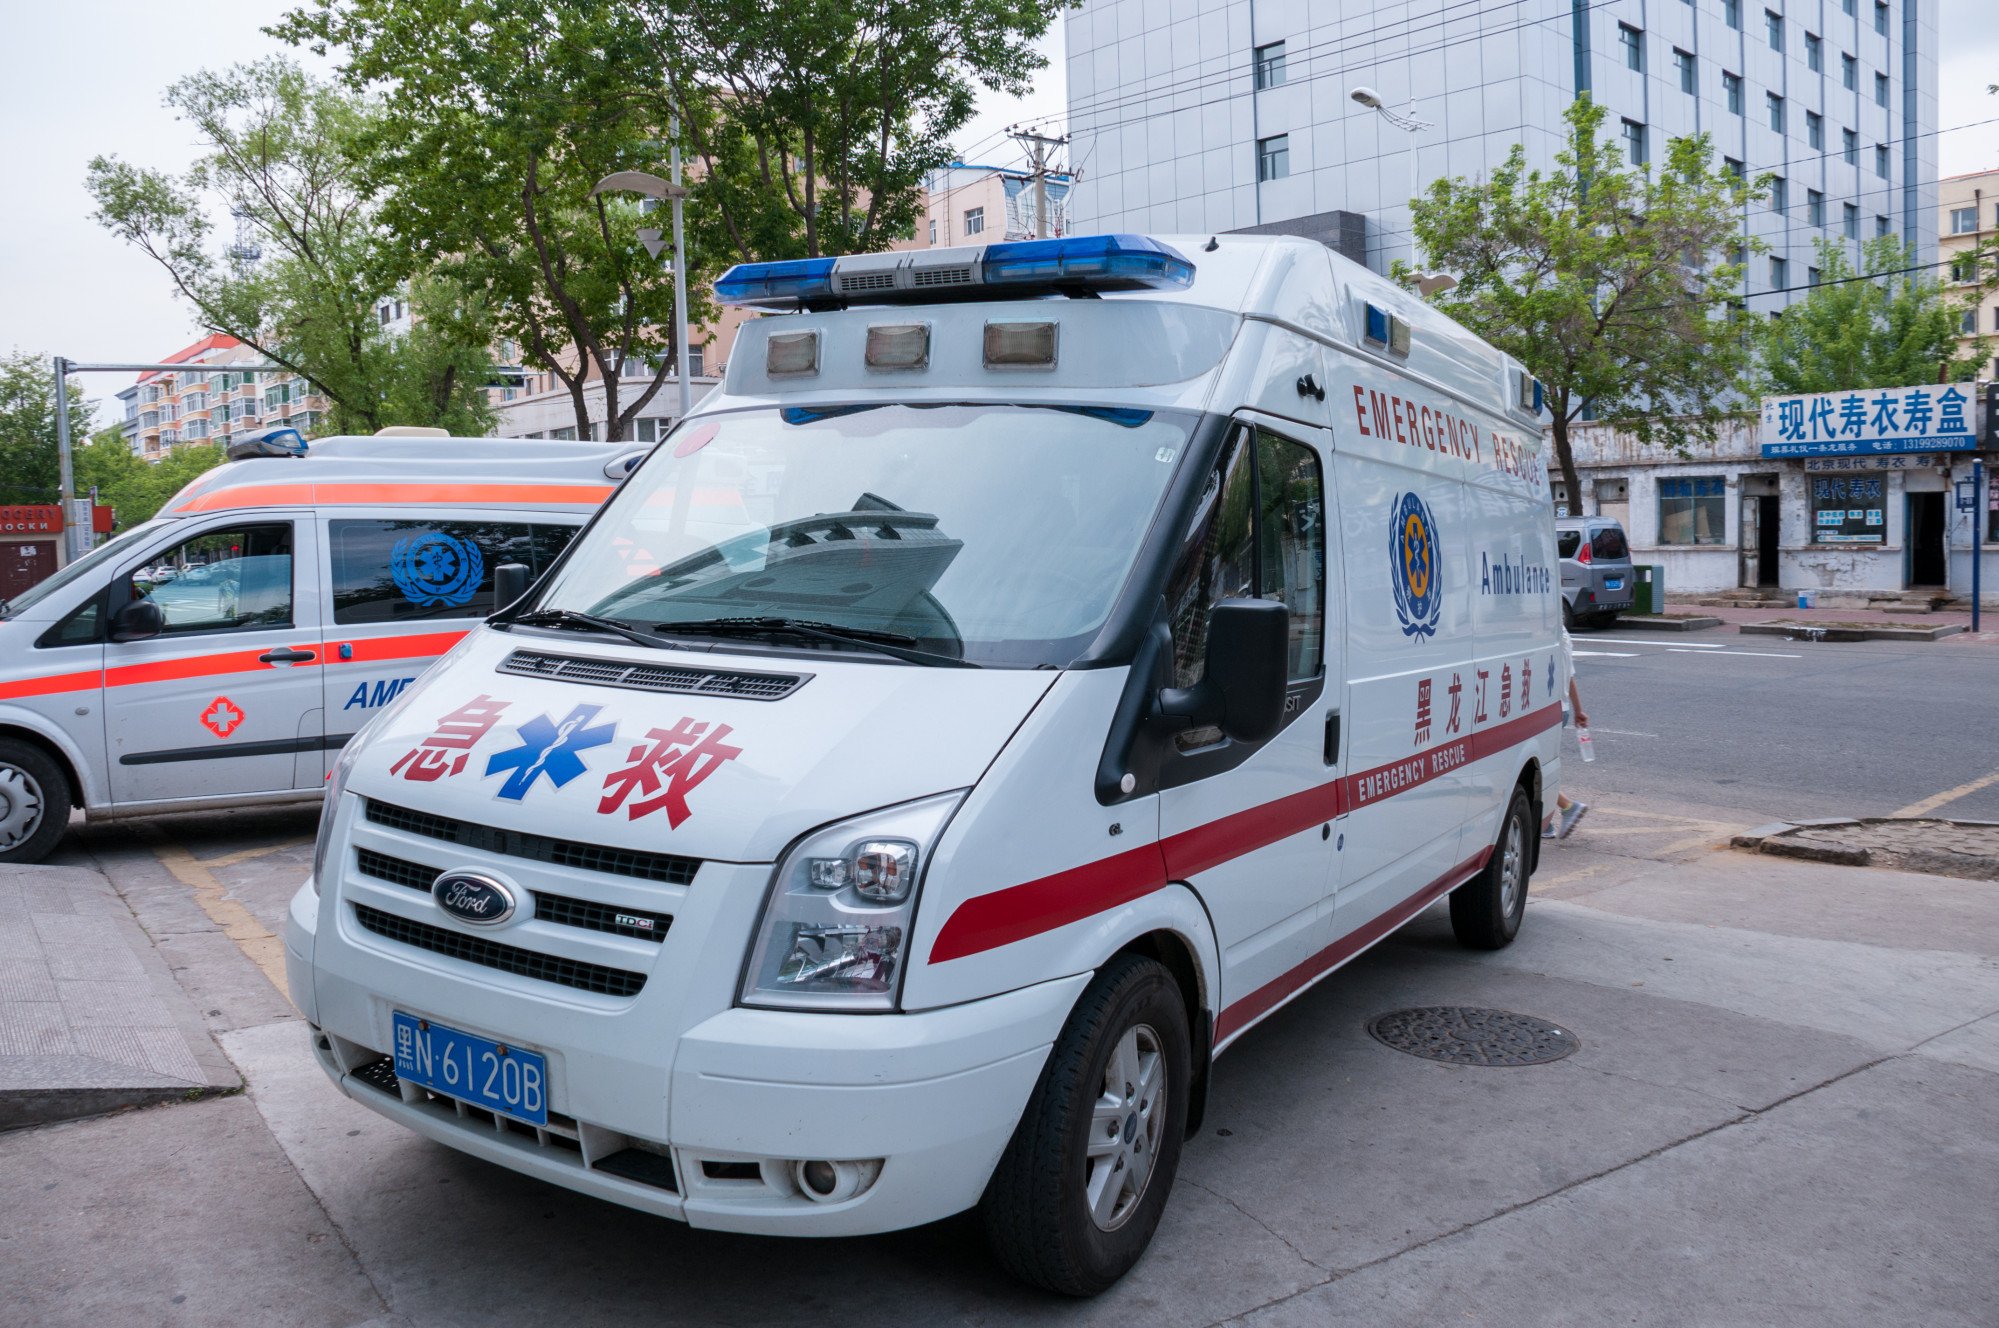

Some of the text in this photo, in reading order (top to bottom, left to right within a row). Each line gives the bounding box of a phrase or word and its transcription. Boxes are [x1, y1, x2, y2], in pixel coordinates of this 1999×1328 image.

[1353, 384, 1540, 486] EMERGENCY RESCUE
[1778, 387, 1968, 441] 现代寿衣寿盒
[1807, 458, 1867, 471] 北京现代
[0, 523, 48, 531] ОСКИ
[1482, 551, 1550, 595] Ambulance
[1414, 658, 1532, 747] 黑龙江急救
[1358, 744, 1466, 801] EMERGENCY RESCUE
[445, 880, 489, 915] Ford
[616, 914, 653, 930] TDCi
